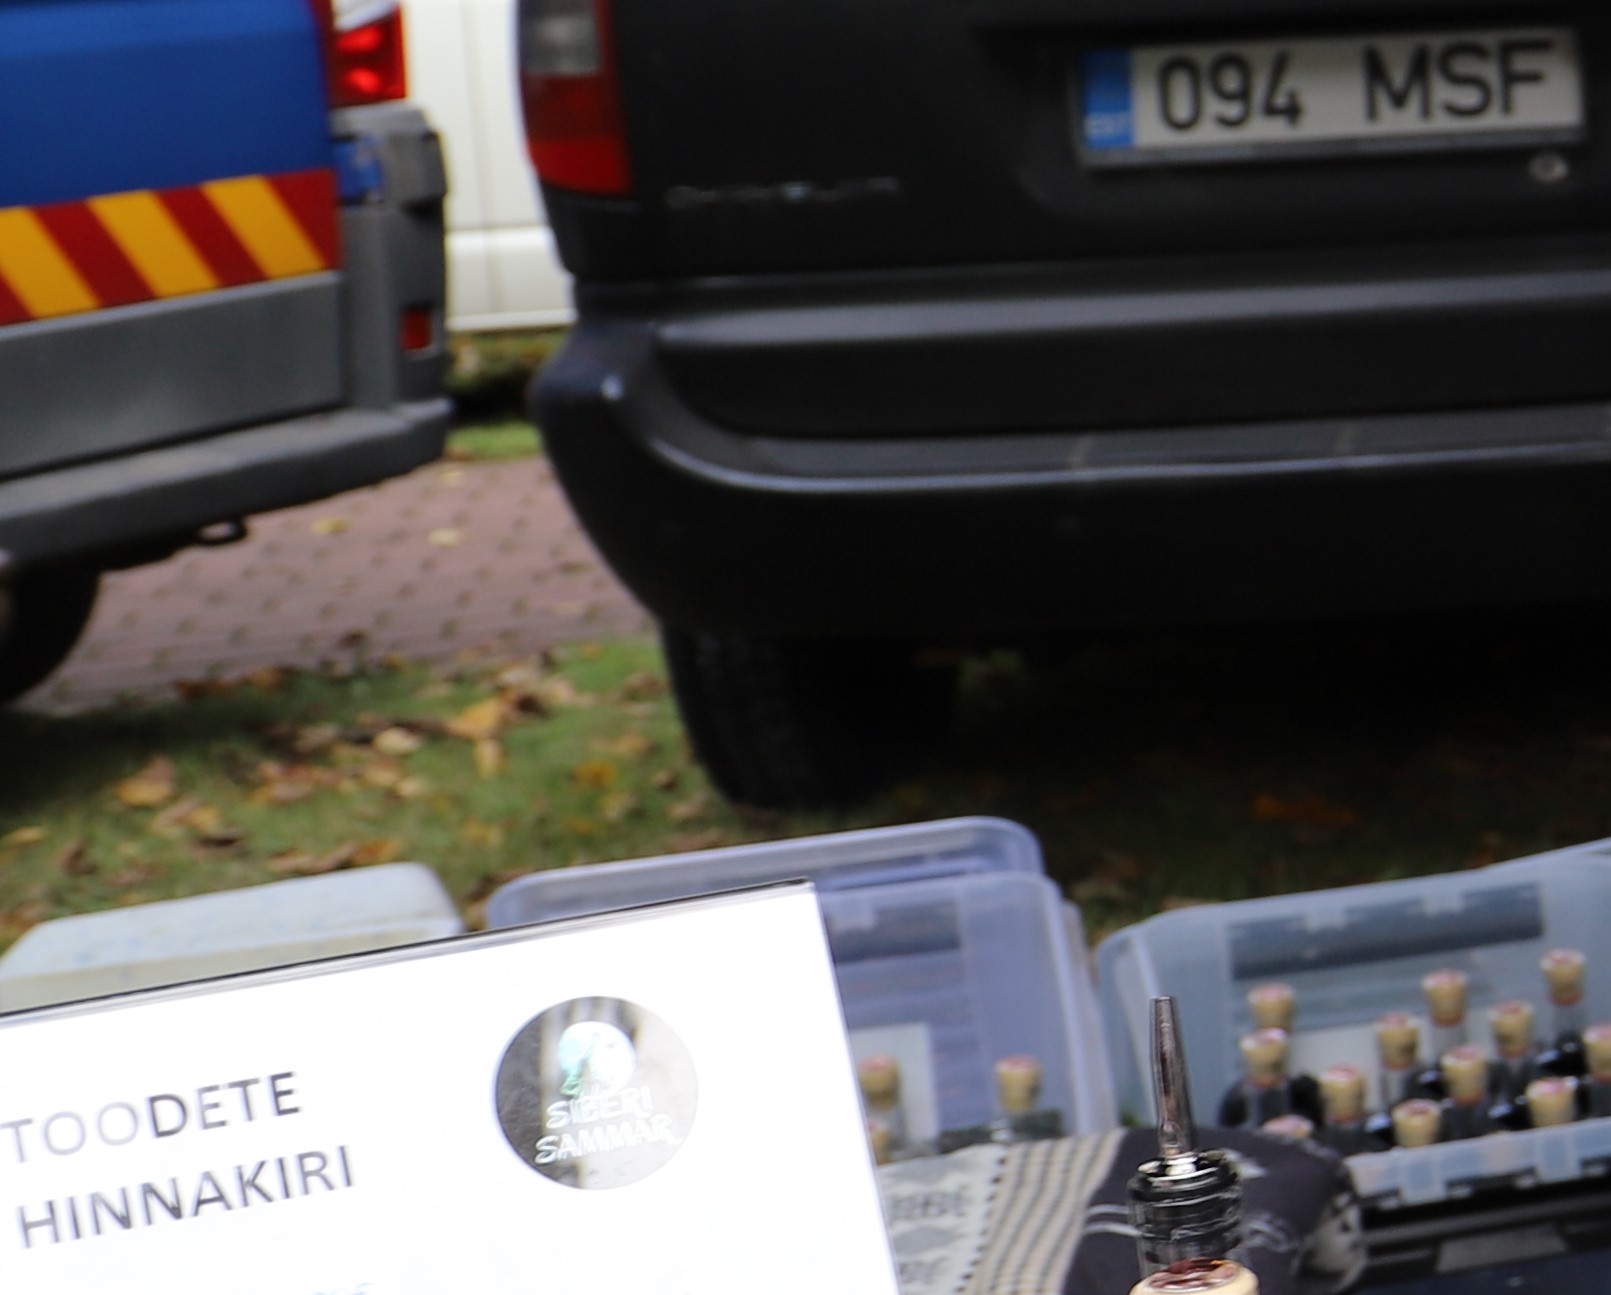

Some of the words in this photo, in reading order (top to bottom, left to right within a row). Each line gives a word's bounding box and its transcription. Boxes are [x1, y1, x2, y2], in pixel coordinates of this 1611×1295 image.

[1156, 51, 1306, 131] 094
[1362, 37, 1552, 122] MSF
[3, 1071, 302, 1165] TOODETE
[535, 1113, 684, 1165] SAMMAR
[16, 1145, 356, 1251] HINNAKIRI
